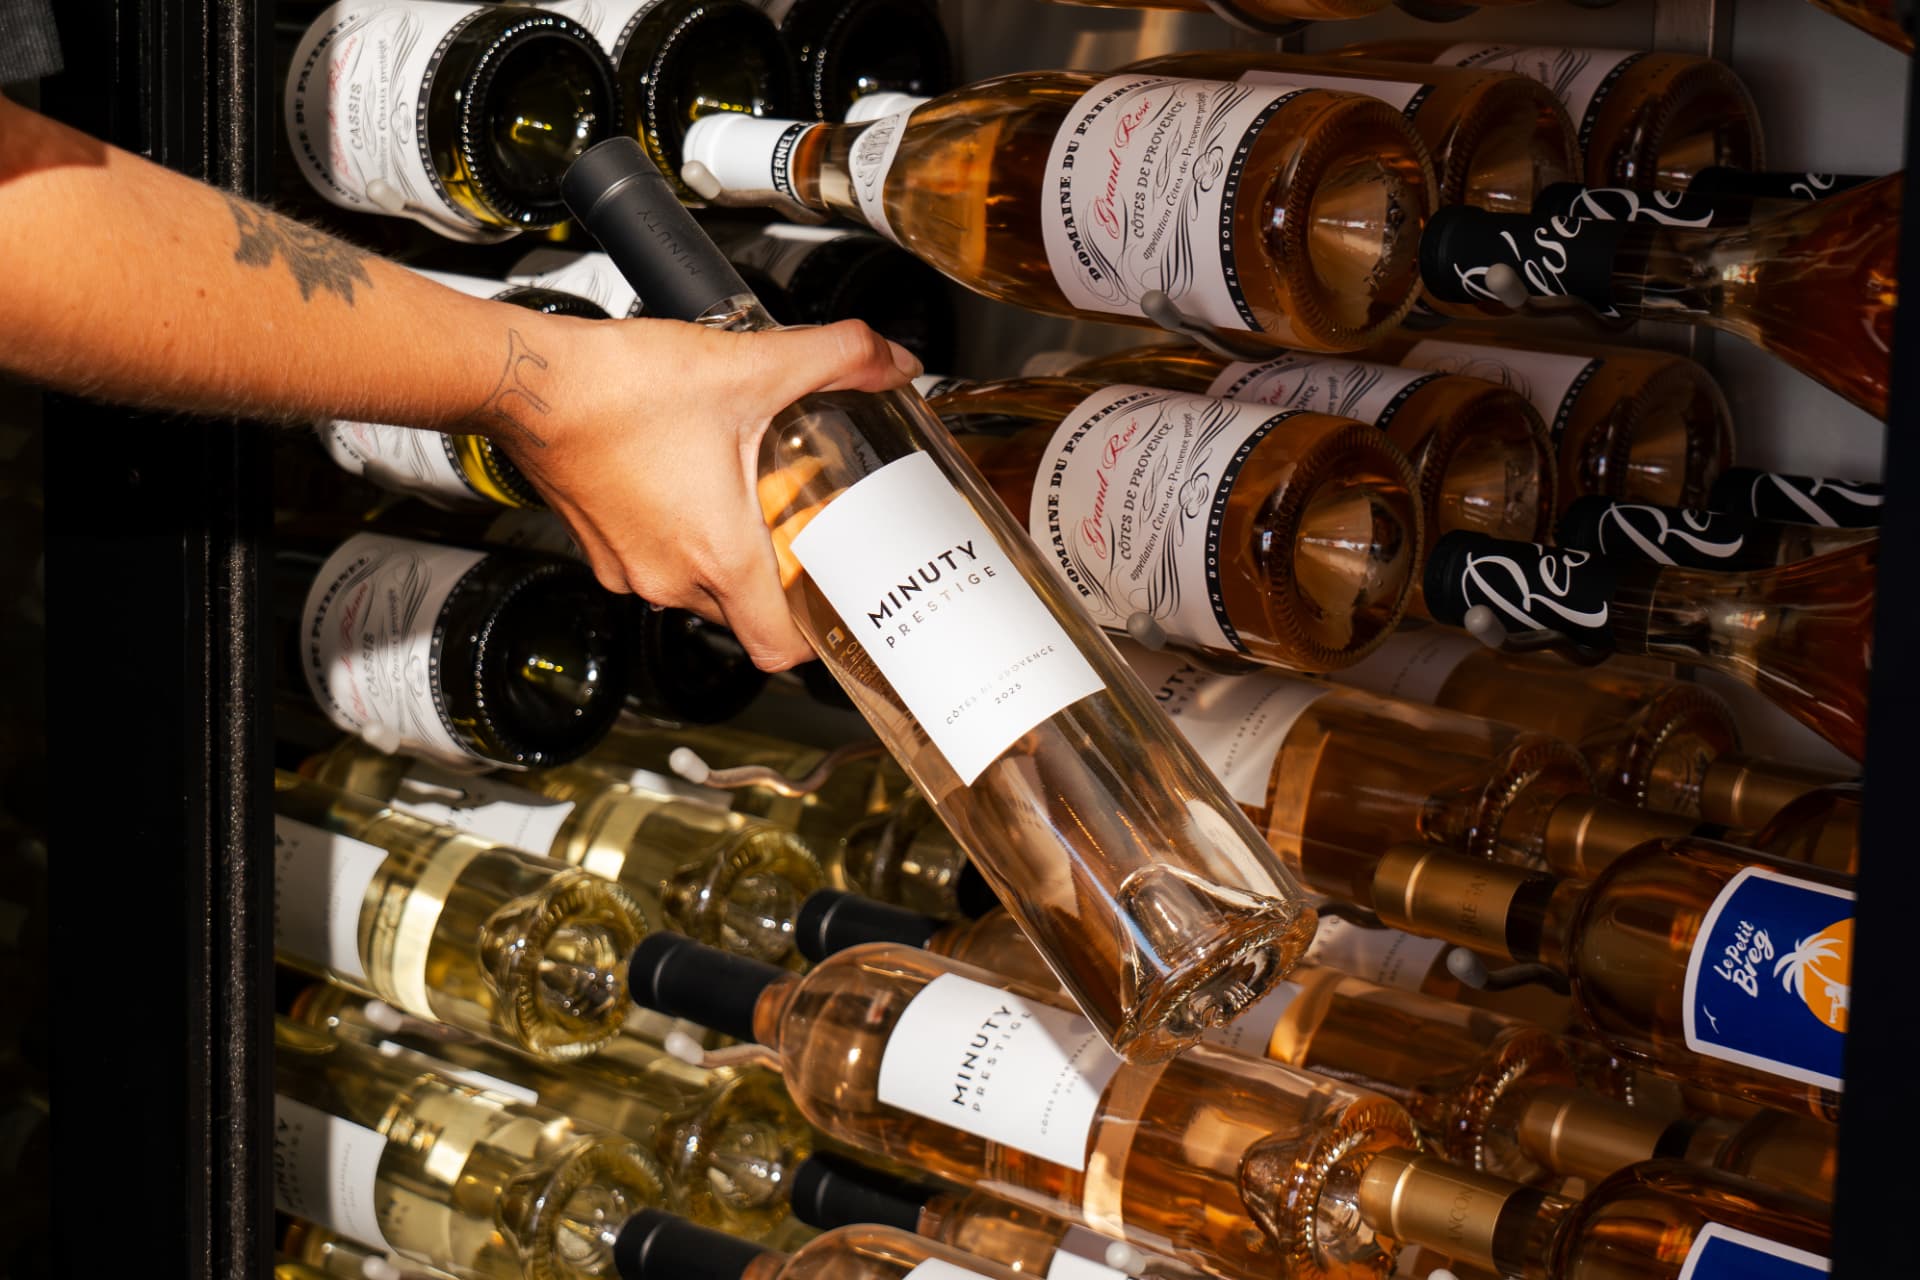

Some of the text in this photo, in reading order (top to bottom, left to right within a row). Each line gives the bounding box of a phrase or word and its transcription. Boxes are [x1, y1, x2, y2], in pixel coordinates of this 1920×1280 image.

[351, 83, 364, 151] CASSIS
[1060, 78, 1170, 284] DOMAINE DU PATERNEL
[1094, 97, 1153, 241] Grand Rosé
[1130, 100, 1188, 240] CÔTES DE PROVENCE
[1220, 146, 1249, 252] BOUTEILLE
[1249, 117, 1266, 135] AU
[636, 209, 703, 277] MINUTY
[1142, 208, 1172, 261] appellation
[1048, 390, 1157, 598] DOMAINE DU PATERNEL
[1081, 417, 1140, 560] Grand Rosé
[1118, 422, 1174, 561] CÔTES DE PROVENCE
[1207, 473, 1235, 580] BOUTEILLE
[1235, 445, 1251, 463] AU
[866, 540, 978, 630] MINUTY
[1130, 529, 1159, 582] appellation
[885, 565, 997, 650] PRESTIGE
[1155, 663, 1197, 701] UTY
[1713, 920, 1755, 981] Le Petit
[1732, 927, 1775, 998] Breg
[951, 1005, 1012, 1107] MINUTY
[972, 1011, 1033, 1113] PRESTIGE
